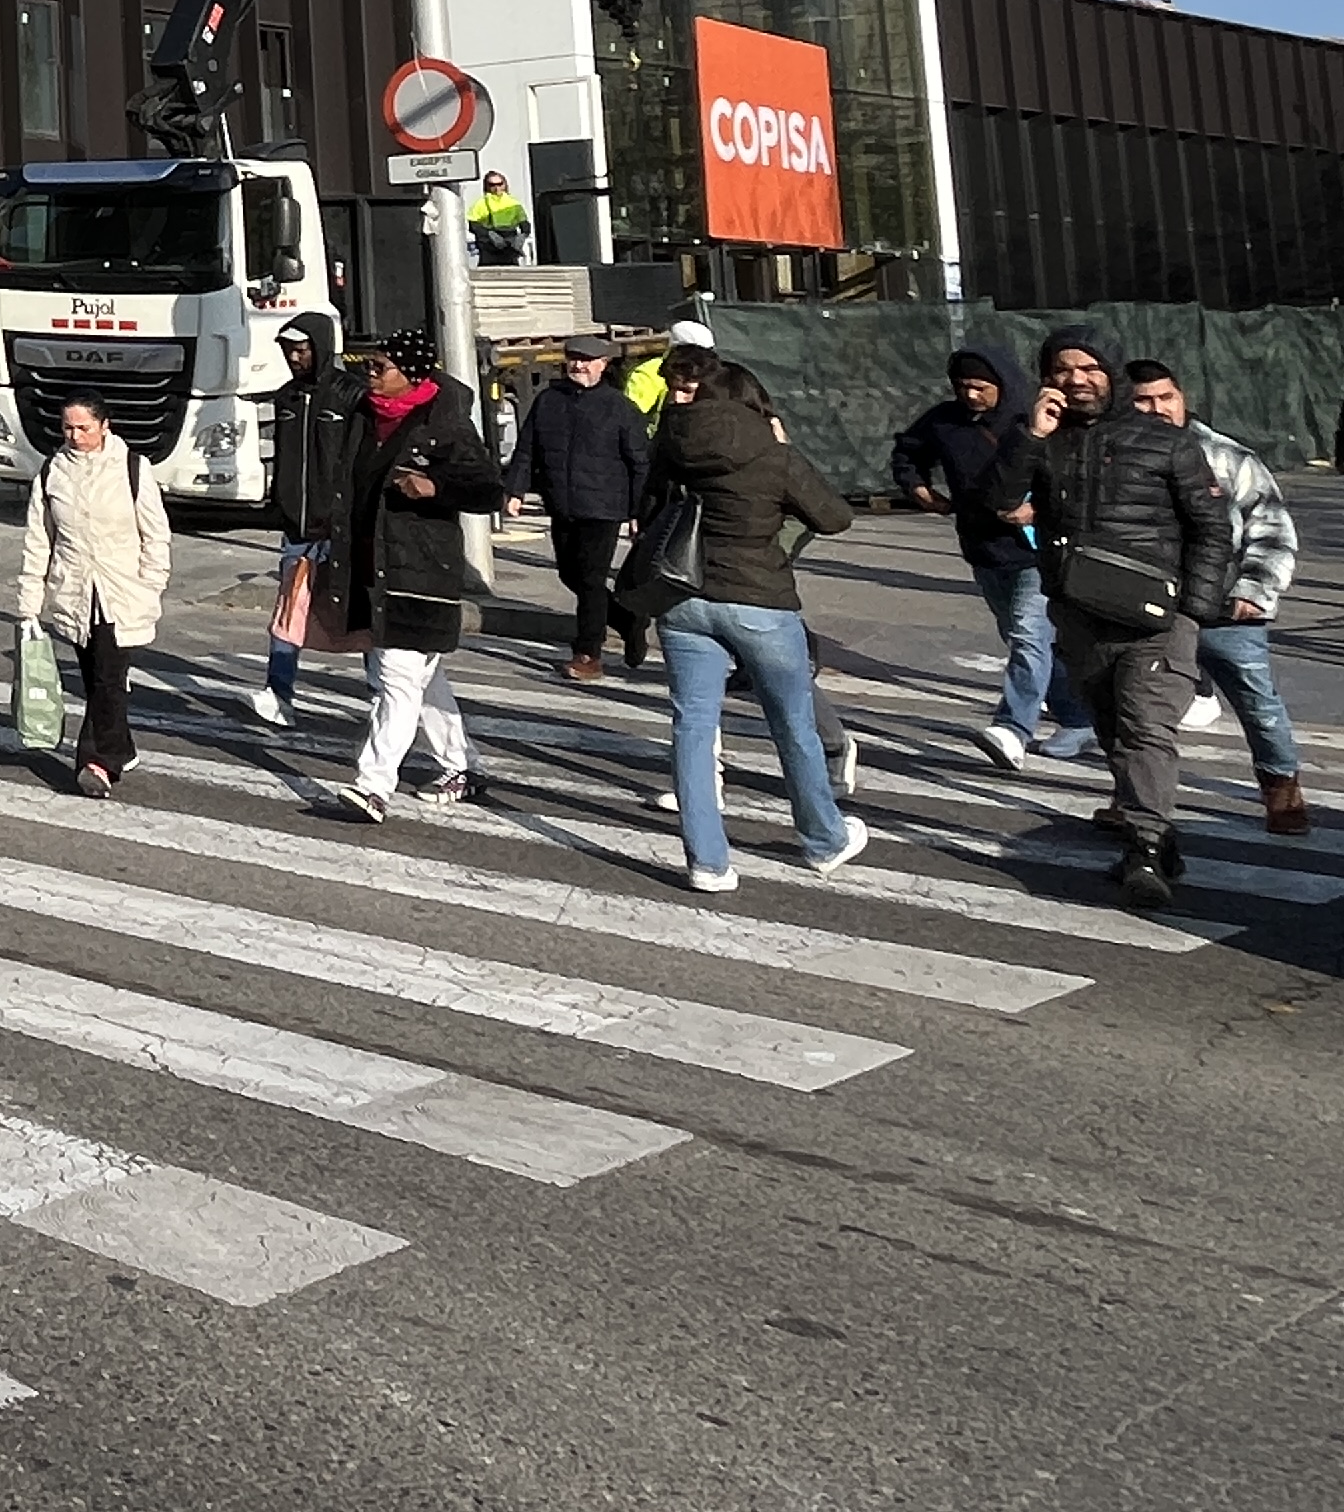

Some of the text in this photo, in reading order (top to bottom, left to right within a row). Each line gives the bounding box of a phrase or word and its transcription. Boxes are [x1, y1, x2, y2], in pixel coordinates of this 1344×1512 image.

[710, 96, 832, 176] COPISA
[71, 297, 115, 319] Pujol
[66, 350, 123, 364] DAF
